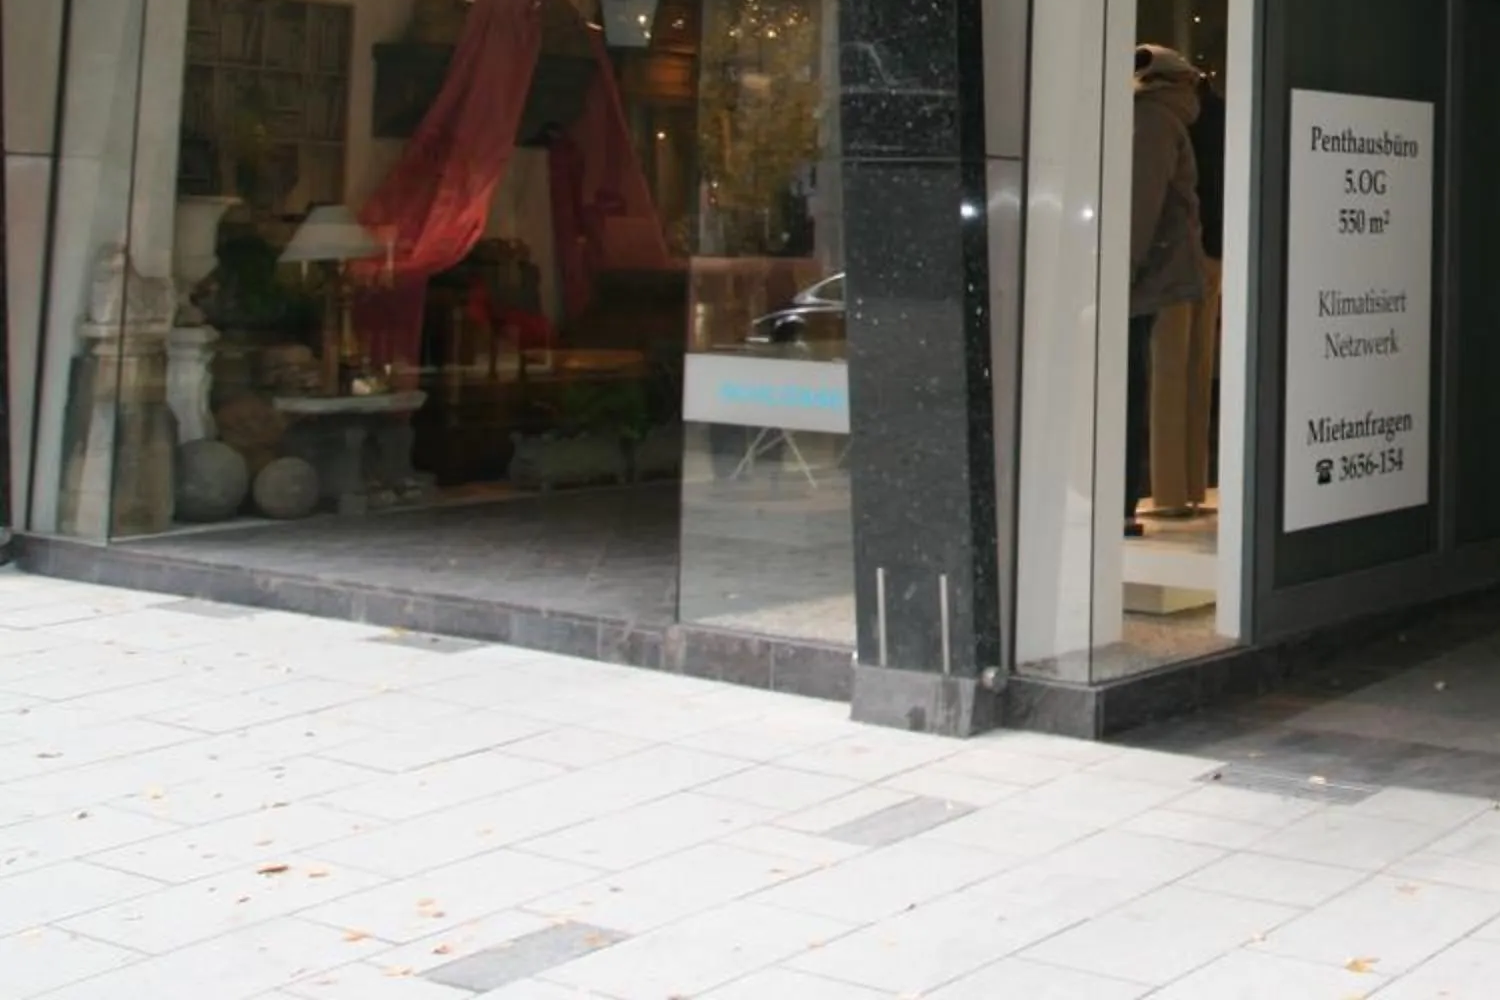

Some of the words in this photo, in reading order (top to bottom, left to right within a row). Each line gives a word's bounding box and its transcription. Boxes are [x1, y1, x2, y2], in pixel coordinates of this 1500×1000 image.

[1310, 126, 1418, 158] Penthausbüro
[1345, 169, 1386, 194] 5.OG
[1339, 209, 1365, 233] 550
[1318, 288, 1407, 317] Klimatisiert
[1324, 329, 1401, 358] Netzwerk
[1307, 411, 1413, 445] Mietanfragen
[1338, 448, 1404, 481] 3656-154
